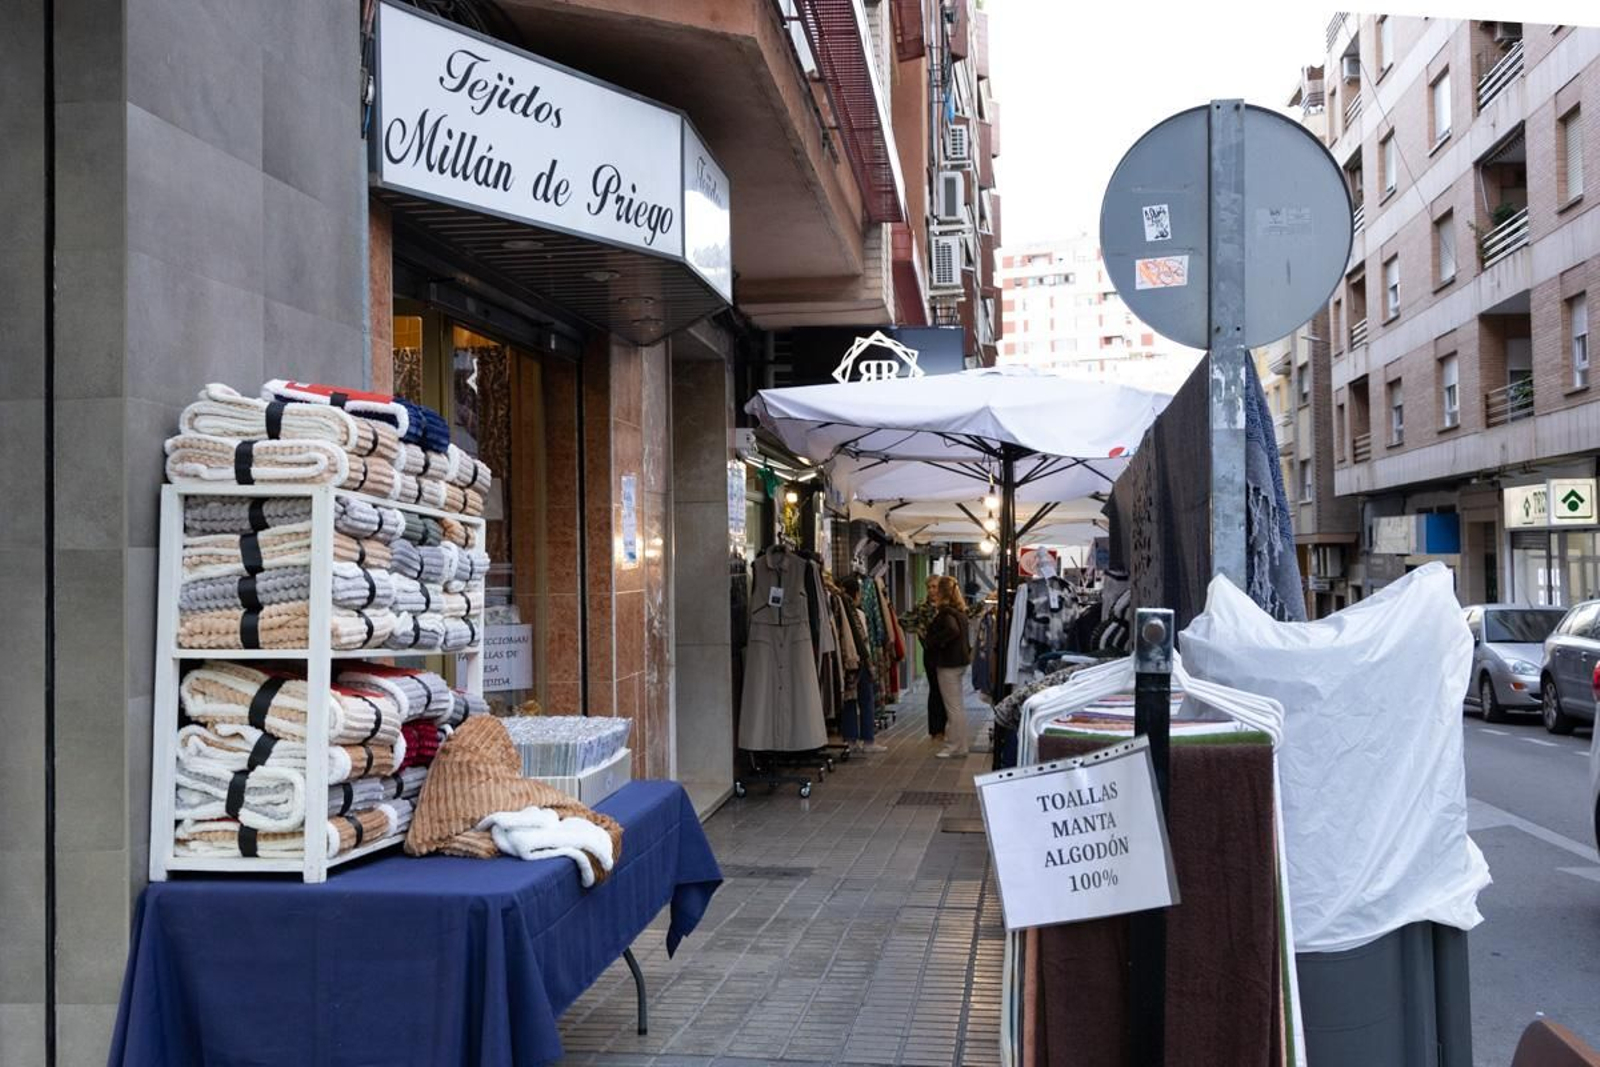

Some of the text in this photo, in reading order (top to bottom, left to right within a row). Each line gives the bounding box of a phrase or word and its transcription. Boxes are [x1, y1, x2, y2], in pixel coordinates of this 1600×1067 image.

[438, 49, 562, 129] Tejidos
[384, 108, 673, 246] Millán de Priego
[1036, 781, 1119, 813] TOALLAS
[1051, 811, 1118, 839] MANTA
[1044, 833, 1130, 868] ALGODÓN
[1069, 868, 1119, 893] 100%
